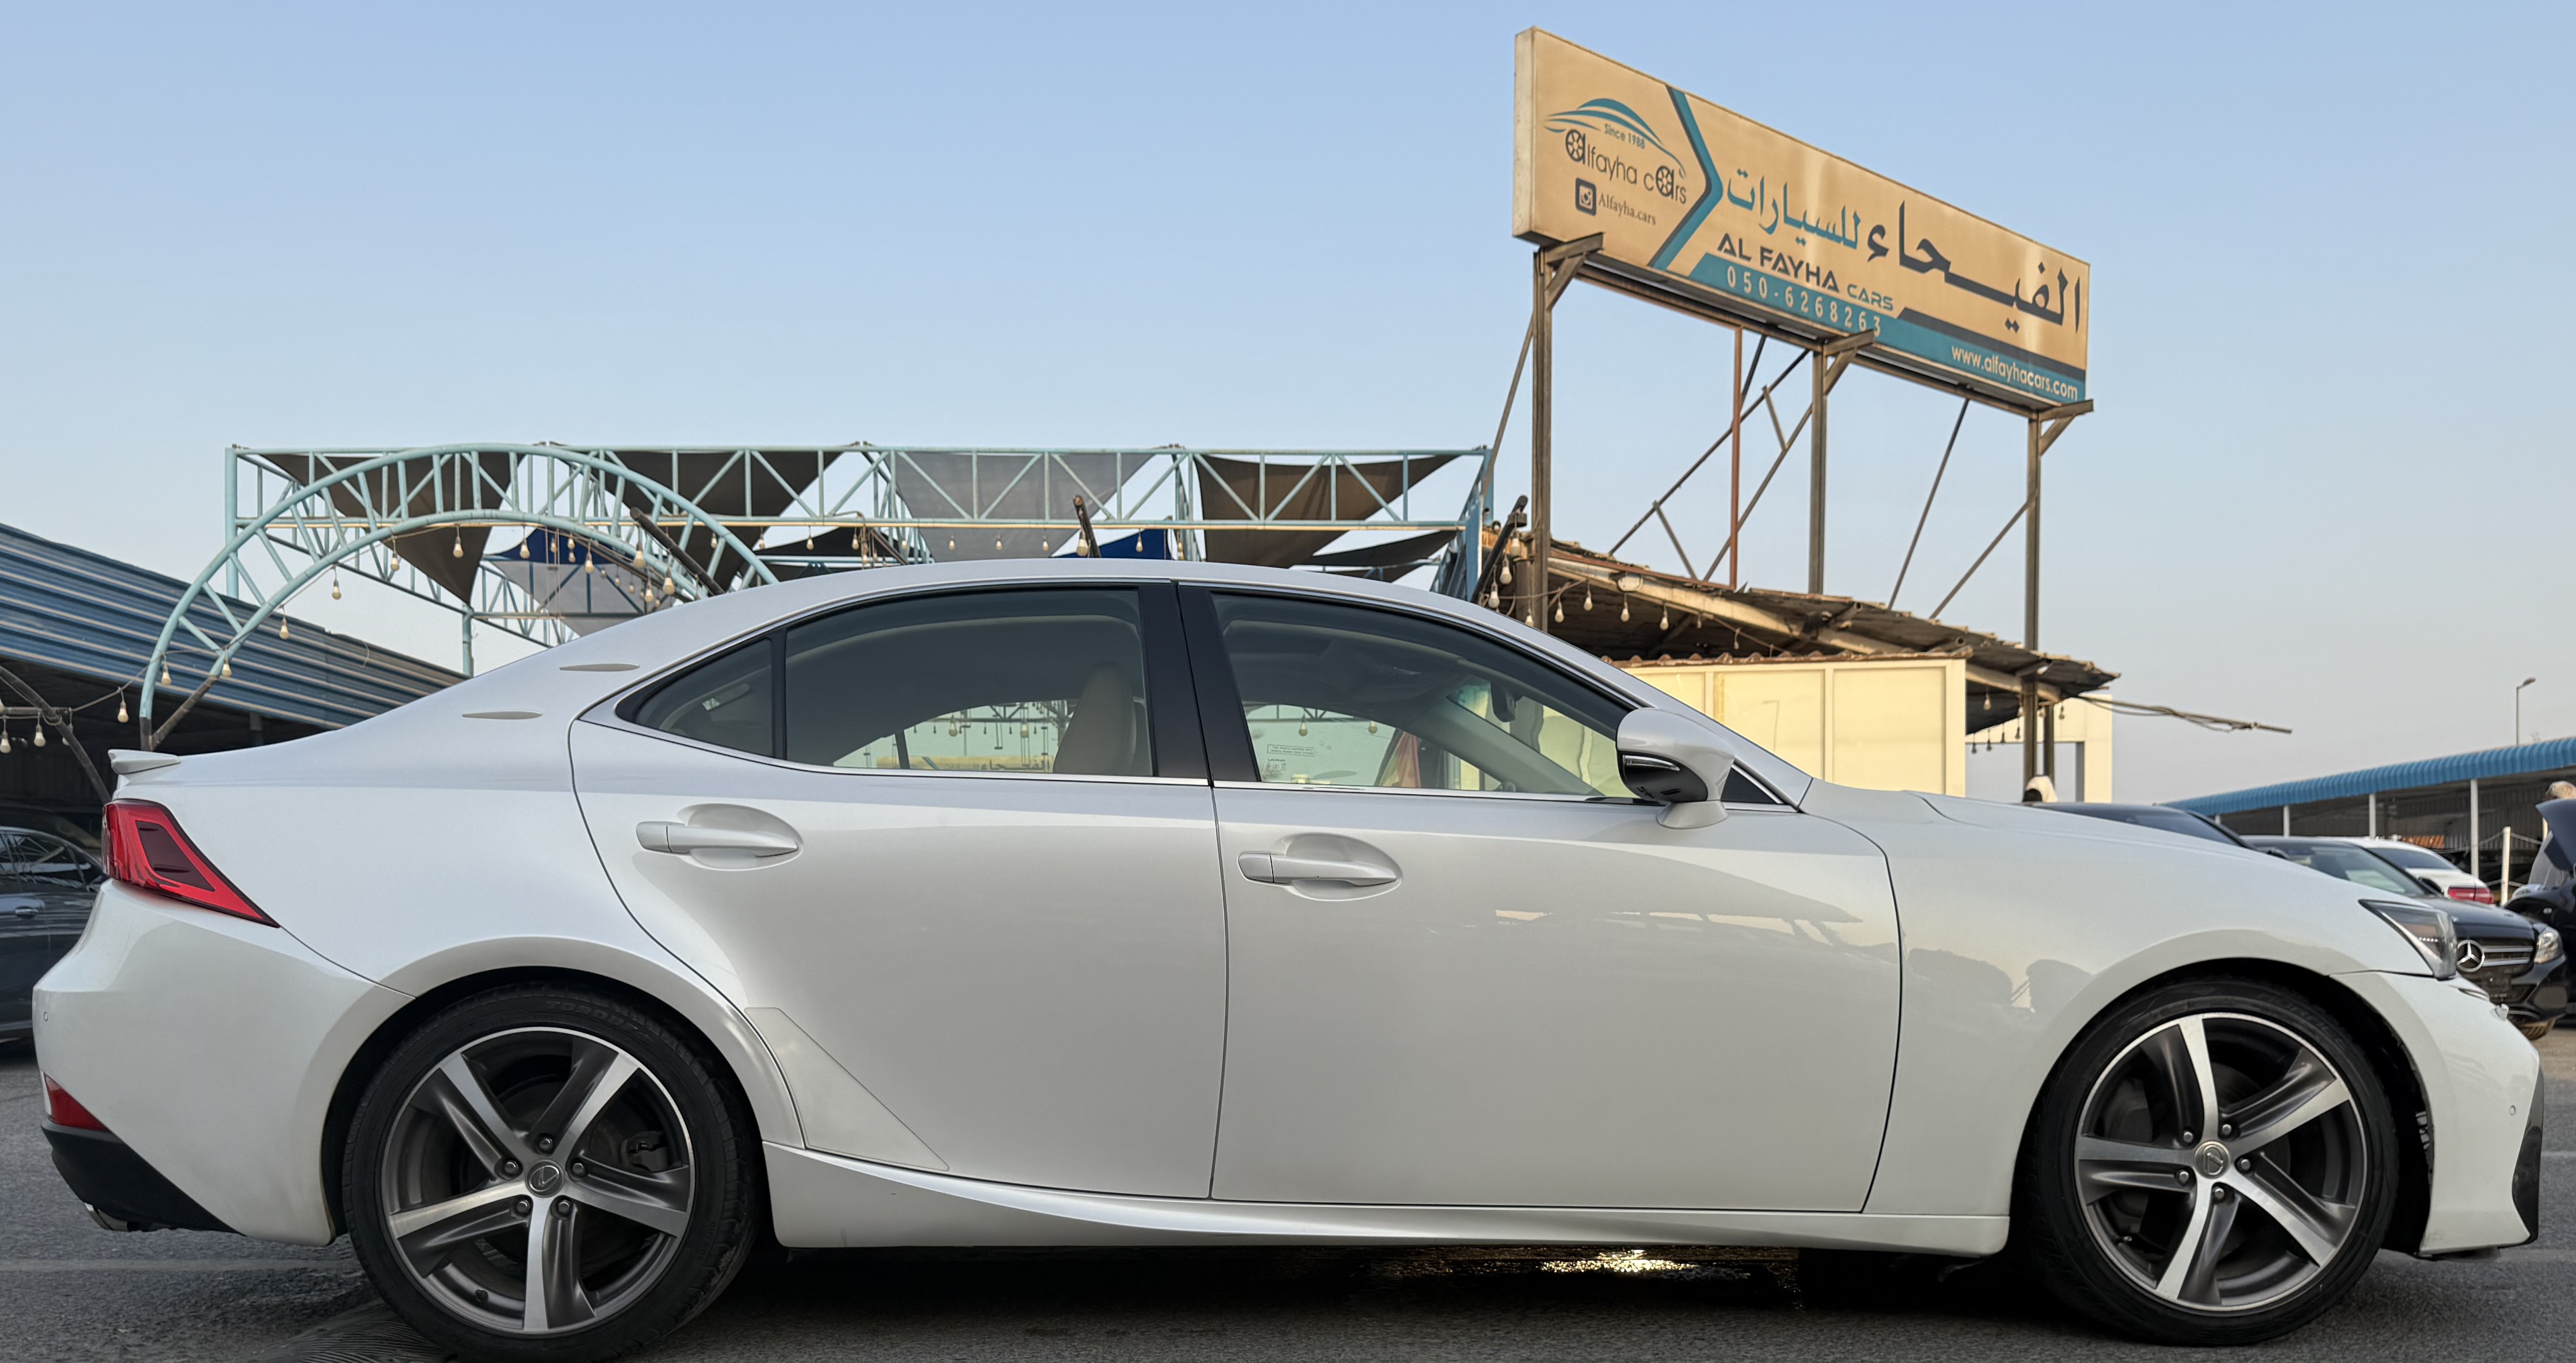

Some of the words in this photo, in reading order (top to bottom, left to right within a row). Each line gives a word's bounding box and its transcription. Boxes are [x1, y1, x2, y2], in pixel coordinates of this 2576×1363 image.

[1565, 129, 1637, 185] alfayha
[1643, 165, 1687, 204] cars
[1604, 123, 1625, 141] Since
[1598, 193, 1656, 225] Alfayha.cars
[1727, 168, 1861, 250] للسيارات
[1717, 233, 1752, 262] AL
[1760, 245, 1840, 293] FAYHA
[1847, 283, 1894, 311] CARS
[1867, 200, 2080, 334] الفيحاء
[1951, 345, 2078, 400] www.alfayhacars.com
